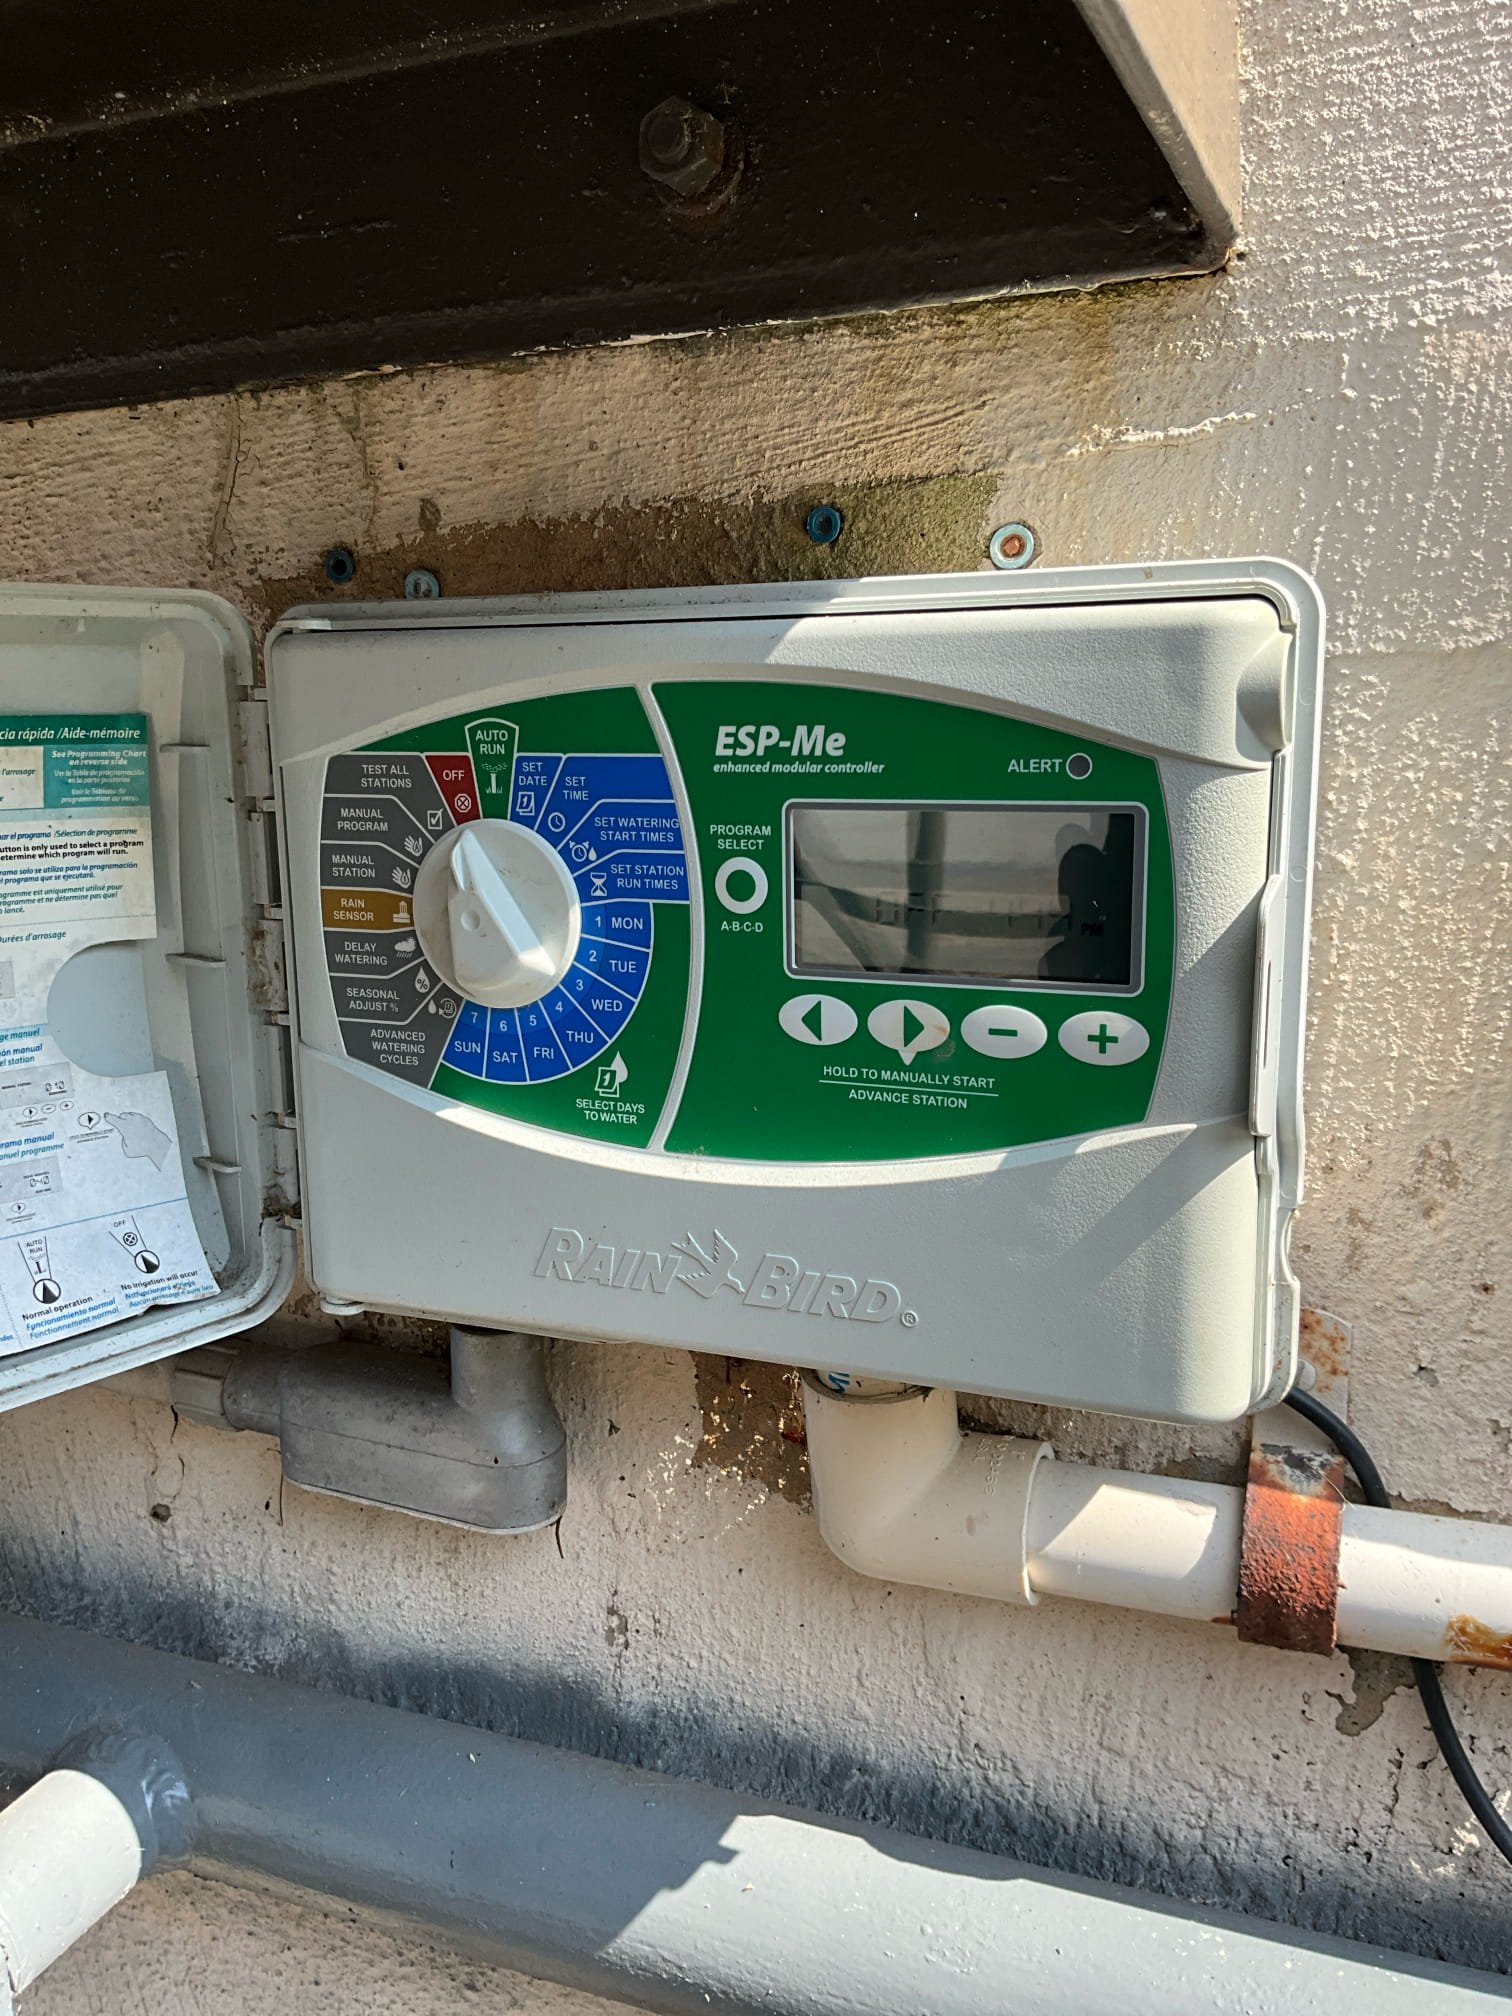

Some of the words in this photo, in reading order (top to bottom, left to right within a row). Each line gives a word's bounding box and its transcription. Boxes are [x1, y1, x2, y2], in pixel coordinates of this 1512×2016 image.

[18, 727, 54, 742] rápida
[475, 730, 509, 742] AUTO
[715, 724, 846, 757] ESP-Me
[52, 750, 66, 758] See
[66, 750, 121, 760] Programming
[122, 749, 146, 758] Chart
[479, 743, 505, 755] RUN
[362, 764, 388, 775] TEST
[390, 764, 410, 775] ALL
[522, 761, 543, 772] SET
[713, 761, 771, 773] enhanced
[771, 761, 823, 773] modular
[824, 761, 885, 774] controller
[1007, 758, 1063, 773] ALERT
[442, 769, 465, 781] OFF
[519, 775, 547, 786] DATE
[361, 778, 412, 788] STATIONS
[565, 776, 586, 787] SET
[562, 790, 589, 801] TIME
[340, 808, 384, 819] MANUAL
[337, 820, 389, 832] PROGRAM
[594, 816, 615, 827] SET
[618, 817, 680, 829] WATERING
[10, 832, 16, 840] el
[16, 831, 52, 841] programa
[96, 828, 138, 838] programme
[709, 824, 772, 836] PROGRAM
[600, 830, 637, 842] START
[639, 831, 674, 843] TIMES
[23, 844, 29, 852] is
[31, 843, 48, 854] only
[50, 841, 68, 850] used
[79, 840, 102, 849] select
[109, 840, 144, 849] program
[717, 838, 765, 851] SELECT
[37, 850, 60, 860] which
[62, 849, 95, 859] program
[96, 847, 111, 856] will
[331, 854, 375, 866] MANUAL
[43, 865, 64, 873] utiliza
[64, 865, 80, 873] para
[81, 863, 89, 871] la
[89, 862, 138, 872] programación
[332, 867, 376, 878] STATION
[610, 863, 632, 875] SET
[634, 864, 684, 876] STATION
[4, 875, 39, 886] programa
[40, 874, 53, 884] que
[617, 878, 641, 889] RUN
[643, 879, 679, 890] TIMES
[33, 889, 43, 897] est
[44, 886, 84, 899] uniquement
[106, 884, 123, 892] pour
[37, 896, 44, 904] et
[89, 893, 102, 901] pas
[340, 898, 365, 908] RAIN
[333, 911, 374, 921] SENSOR
[595, 915, 601, 927] 1
[611, 917, 644, 930] MON
[344, 941, 377, 952] DELAY
[334, 954, 388, 966] WATERING
[588, 951, 597, 962] 2
[609, 960, 637, 973] TUE
[346, 988, 400, 1000] SEASONAL
[575, 979, 583, 991] 3
[591, 998, 623, 1012] WED
[349, 1000, 388, 1012] ADJUST
[555, 1001, 563, 1013] 4
[470, 1012, 478, 1024] 7
[529, 1015, 537, 1026] 5
[500, 1020, 508, 1032] 6
[10, 1027, 40, 1040] manuel
[370, 1029, 426, 1042] ADVANCED
[566, 1030, 594, 1044] THU
[13, 1042, 43, 1055] manual
[372, 1042, 425, 1054] WATERING
[454, 1041, 481, 1054] SUN
[533, 1046, 555, 1060] FRI
[8, 1055, 35, 1066] station
[379, 1054, 419, 1065] CYCLES
[492, 1051, 518, 1064] SAT
[823, 1065, 858, 1079] HOLD
[861, 1068, 878, 1080] TO
[881, 1070, 950, 1086] MANUALLY
[952, 1075, 996, 1089] START
[848, 1089, 910, 1104] ADVANCE
[911, 1093, 968, 1109] STATION
[576, 1098, 616, 1111] SELECT
[617, 1102, 645, 1114] DAYS
[583, 1110, 599, 1121] TO
[600, 1111, 637, 1124] WATER
[24, 1131, 55, 1145] manual
[20, 1142, 65, 1158] programme
[113, 1219, 126, 1229] OFF
[26, 1238, 43, 1248] AUTO
[29, 1246, 43, 1255] RUN
[133, 1277, 165, 1289] irrigation
[166, 1272, 179, 1282] will
[179, 1270, 198, 1279] occur
[534, 1227, 682, 1294] RAIN
[743, 1253, 901, 1323] BIRD
[22, 1306, 53, 1321] Normal
[53, 1295, 94, 1312] operation
[26, 1308, 88, 1331] Funcionamiento
[88, 1297, 116, 1313] normal
[30, 1316, 91, 1339] Fonctionnement
[92, 1306, 119, 1321] normal
